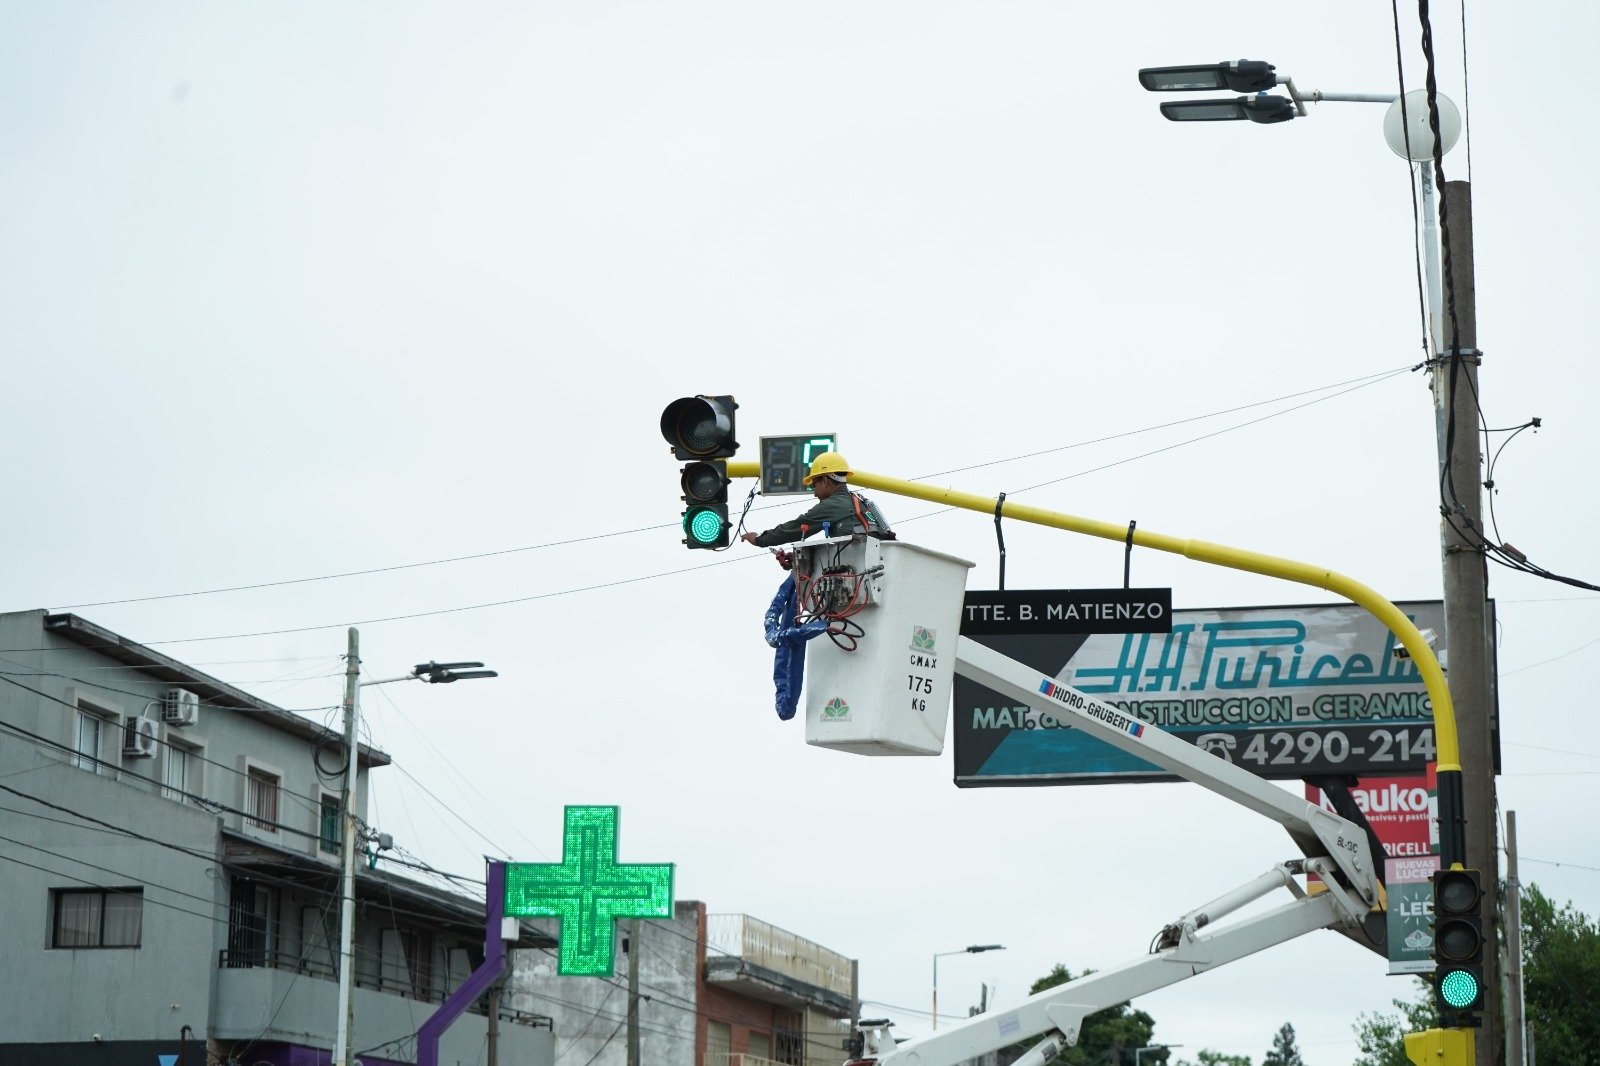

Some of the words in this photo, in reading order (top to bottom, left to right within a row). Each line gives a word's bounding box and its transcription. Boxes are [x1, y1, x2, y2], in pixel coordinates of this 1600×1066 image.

[965, 604, 1011, 621] TTE.
[1019, 604, 1039, 620] B.
[1046, 602, 1163, 620] MATIENZO
[910, 655, 937, 668] CMAX
[908, 675, 933, 694] 175
[912, 698, 926, 711] KG
[972, 706, 1036, 729] MAT.
[1117, 695, 1292, 725] NSTRUCCION
[1312, 691, 1433, 720] CERAMIC
[1242, 728, 1437, 765] 4290-214
[1319, 783, 1429, 813] auko
[1365, 813, 1397, 822] hesivos
[1381, 842, 1430, 856] RICELL
[1394, 860, 1435, 870] NUEVAS
[1395, 868, 1435, 879] LUCES
